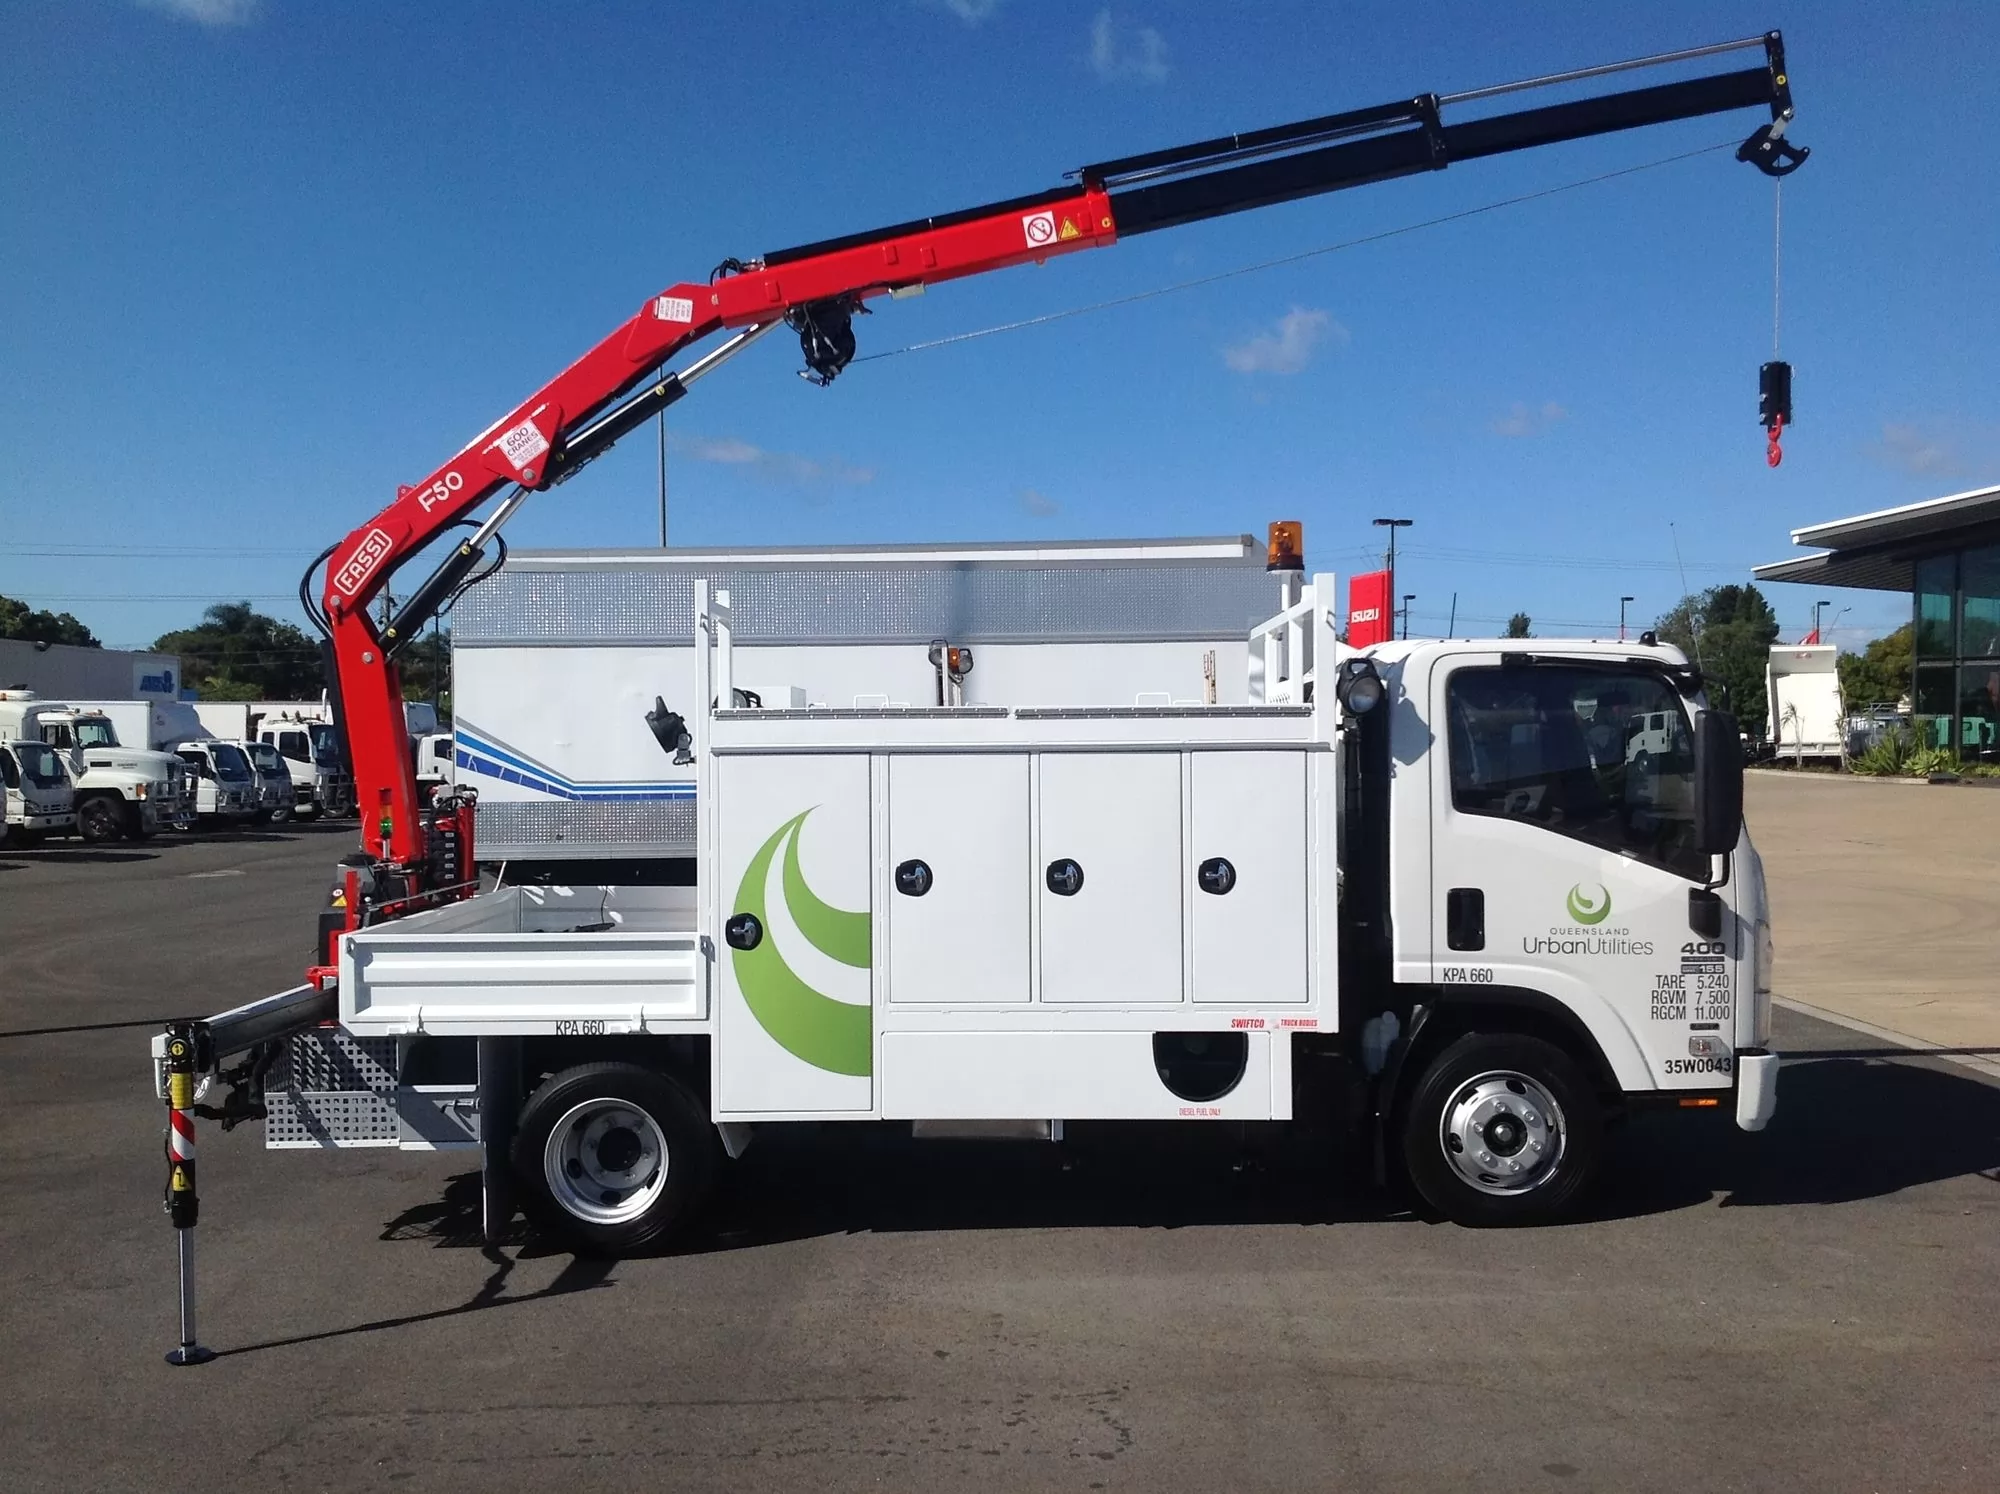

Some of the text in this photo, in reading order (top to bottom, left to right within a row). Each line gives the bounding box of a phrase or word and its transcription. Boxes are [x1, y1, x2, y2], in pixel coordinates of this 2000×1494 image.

[507, 432, 538, 456] CRANES
[418, 471, 463, 512] F50
[340, 535, 387, 589] FASSI
[1351, 608, 1379, 623] ISUZU
[1550, 927, 1629, 935] QUEENSLAND
[1523, 937, 1654, 955] UrbanUtilities
[1681, 942, 1726, 954] 400
[1443, 968, 1493, 982] KPA 660
[1699, 965, 1724, 973] 155
[1656, 974, 1729, 989] TARE 5.240
[1651, 990, 1686, 1004] RGVM
[1651, 1005, 1730, 1020] RGCM 11.000
[555, 1020, 605, 1035] KPA 660
[1231, 1018, 1265, 1028] SWIFTCO
[1664, 1058, 1731, 1074] 35W0043
